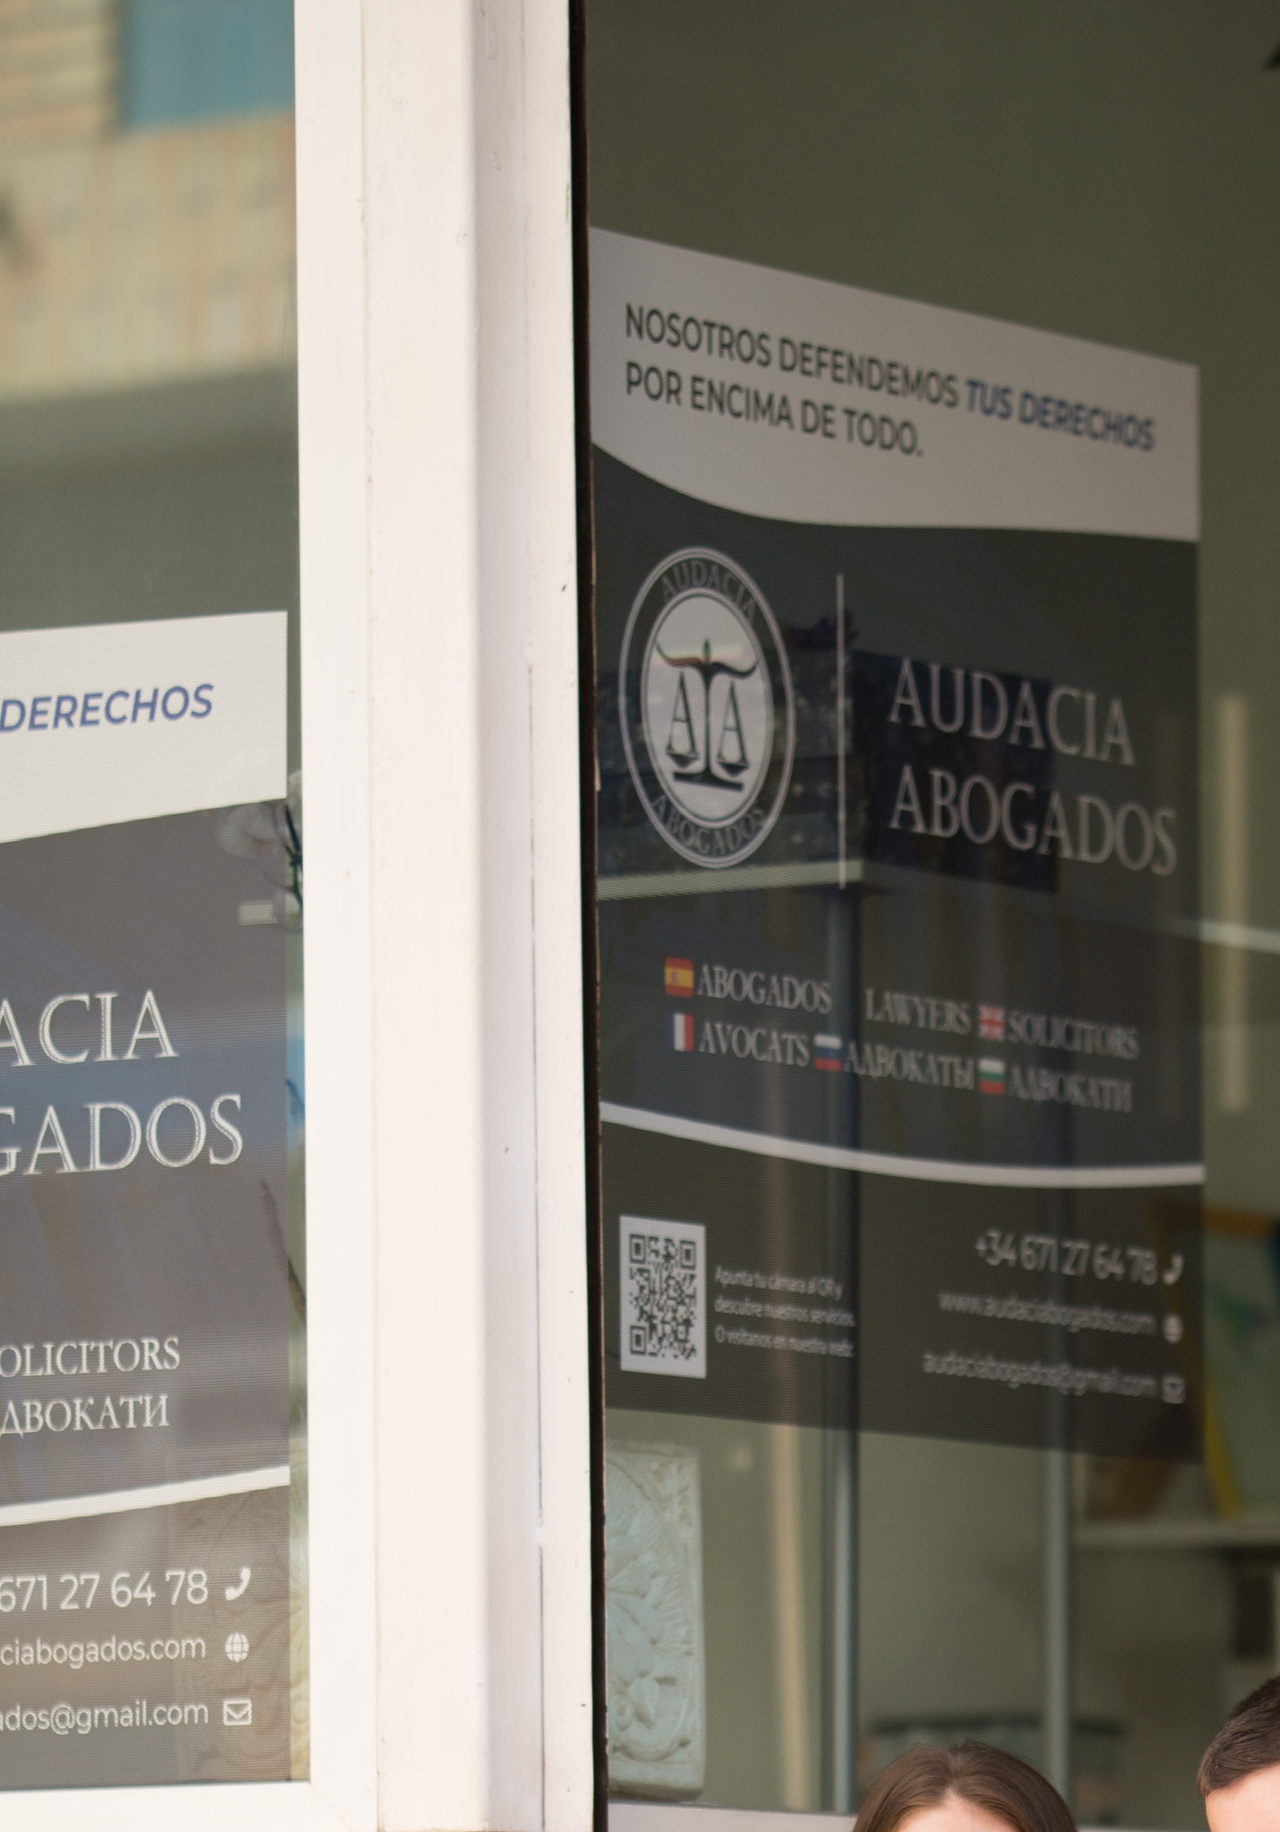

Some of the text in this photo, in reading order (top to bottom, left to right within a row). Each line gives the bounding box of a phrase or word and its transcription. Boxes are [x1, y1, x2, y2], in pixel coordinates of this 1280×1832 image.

[625, 303, 1156, 451] NOSOTROS DEFENDEMOS TUS DERECHOS
[626, 360, 923, 457] POR ENCIMA DE TODO.
[661, 561, 757, 622] AUDACIA
[0, 683, 214, 733] DERECHOS
[887, 656, 1135, 767] AUDACIA
[652, 793, 765, 855] ABOGADOS
[889, 763, 1178, 876] ABOGADOS
[697, 963, 1140, 1061] ABOGADOS LAWYERS SOLICITORS
[700, 1020, 810, 1067] AVOCATS
[975, 1228, 1159, 1286] +34 671 27 64 78
[0, 1336, 180, 1378] OLICITORS
[0, 1568, 208, 1612] 671 27 64 78
[0, 1635, 206, 1669] ciabogados.com
